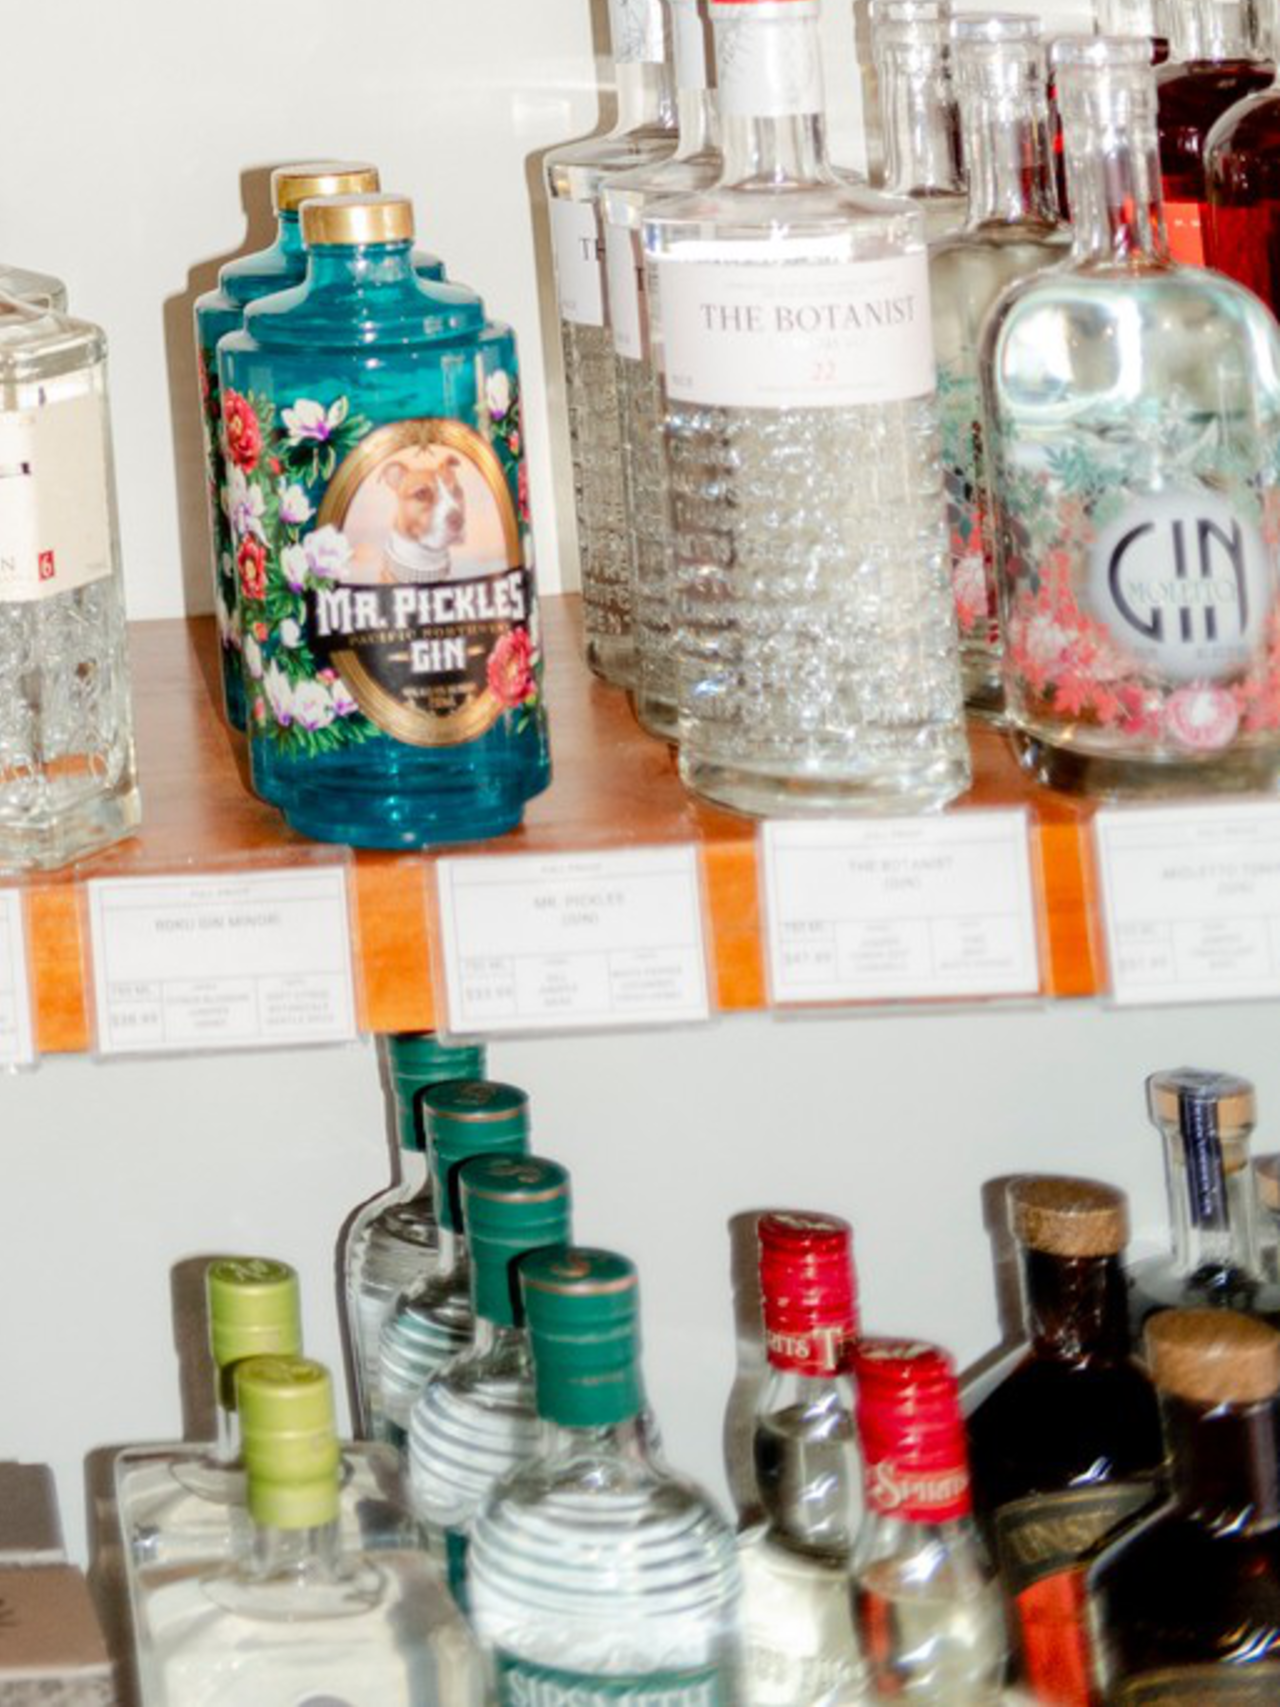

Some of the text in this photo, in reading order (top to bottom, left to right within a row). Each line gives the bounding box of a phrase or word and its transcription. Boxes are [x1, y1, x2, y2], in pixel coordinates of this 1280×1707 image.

[700, 294, 915, 333] THE BOTANIST
[393, 571, 524, 629] PICKLES
[411, 638, 466, 674] GIN
